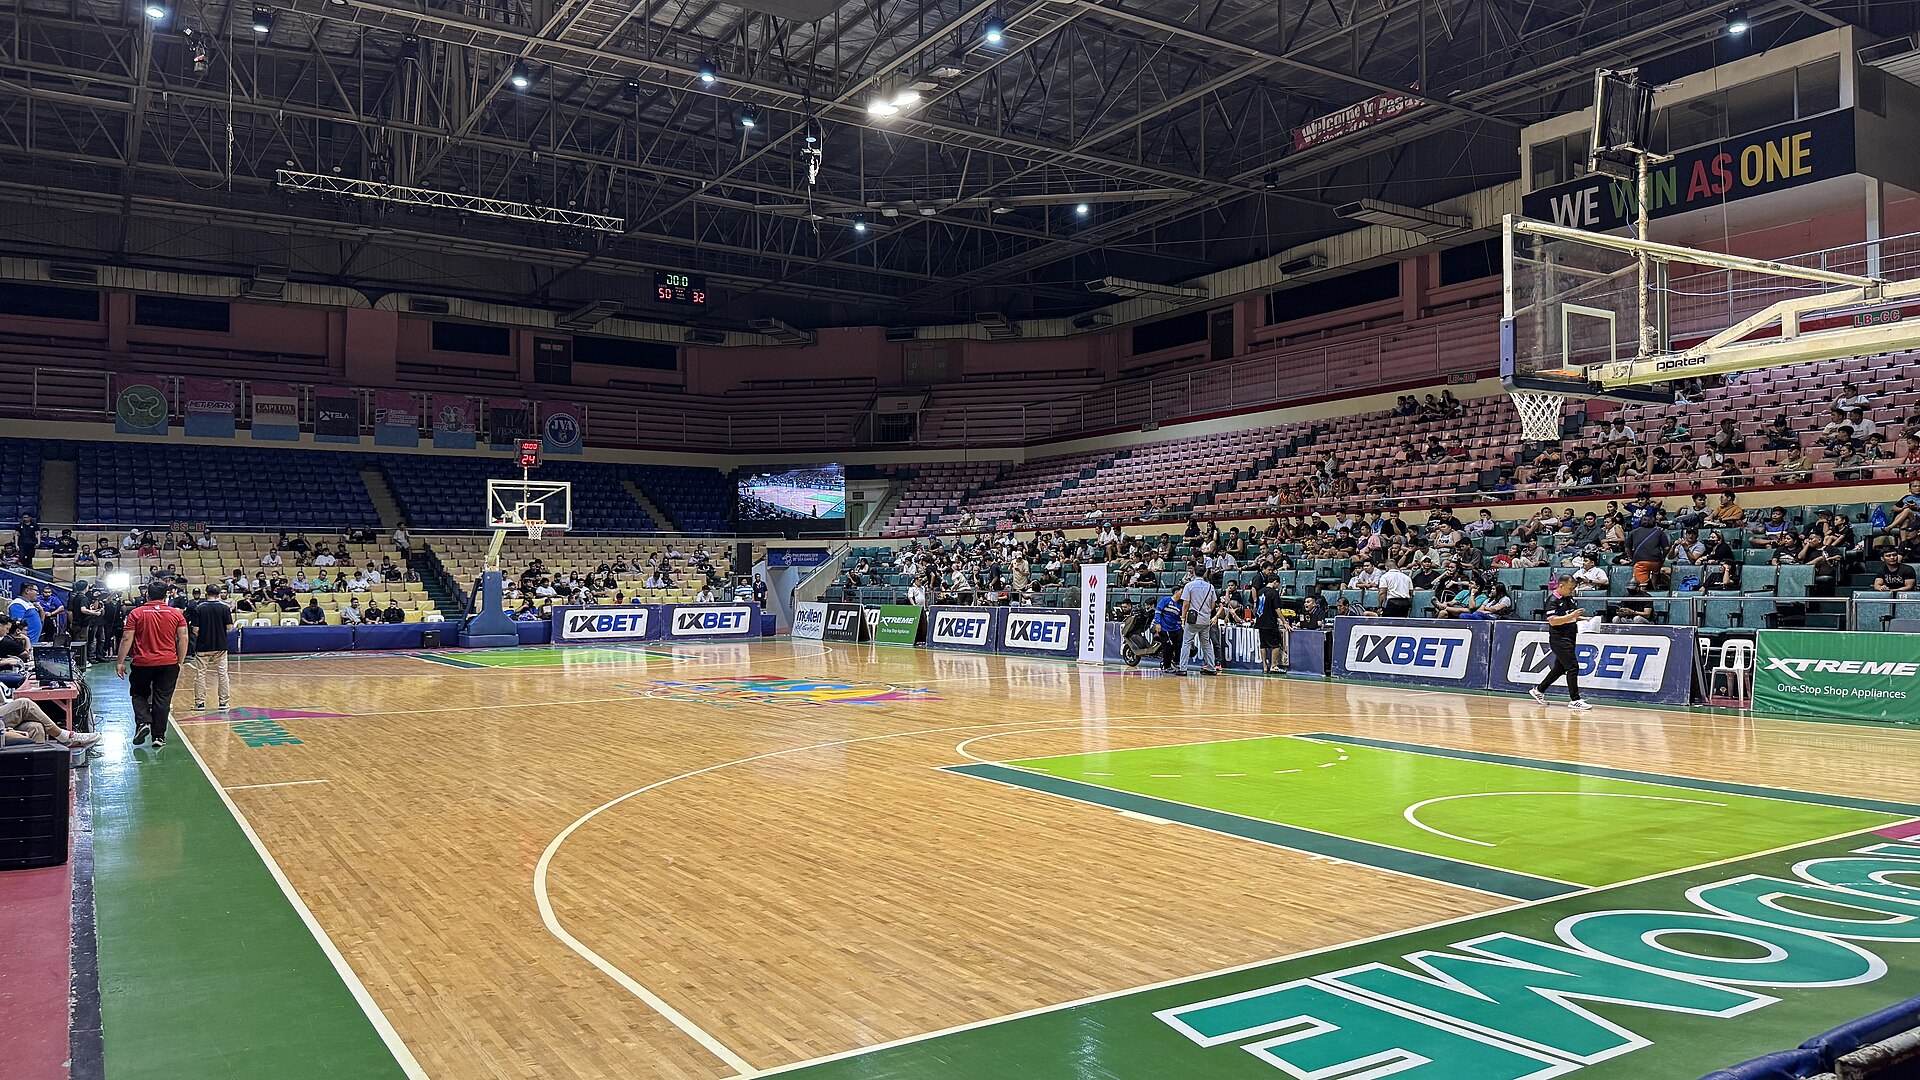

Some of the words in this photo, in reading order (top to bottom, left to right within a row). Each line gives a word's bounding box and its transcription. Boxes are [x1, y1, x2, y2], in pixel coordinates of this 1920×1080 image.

[1550, 186, 1599, 229] WE
[1609, 166, 1677, 219] WIN
[1686, 152, 1733, 202] AS
[1740, 130, 1812, 188] ONE
[658, 287, 672, 299] 50
[693, 291, 705, 303] 32
[1854, 309, 1900, 327] LB-CC
[550, 419, 574, 431] JVA
[521, 454, 536, 465] 24
[569, 614, 643, 633] 1XBET
[678, 611, 746, 630] 1XBET
[796, 609, 823, 623] molten
[880, 616, 915, 627] XTREME
[1087, 592, 1096, 652] SUZUKI
[937, 617, 987, 639] 1XBET
[1010, 620, 1066, 643] 1XBET
[1355, 634, 1464, 669] 1XBET
[1764, 657, 1920, 680] XTREME
[1777, 683, 1822, 696] One-Stop
[1823, 685, 1849, 698] Shop
[1850, 687, 1907, 700] Appliances
